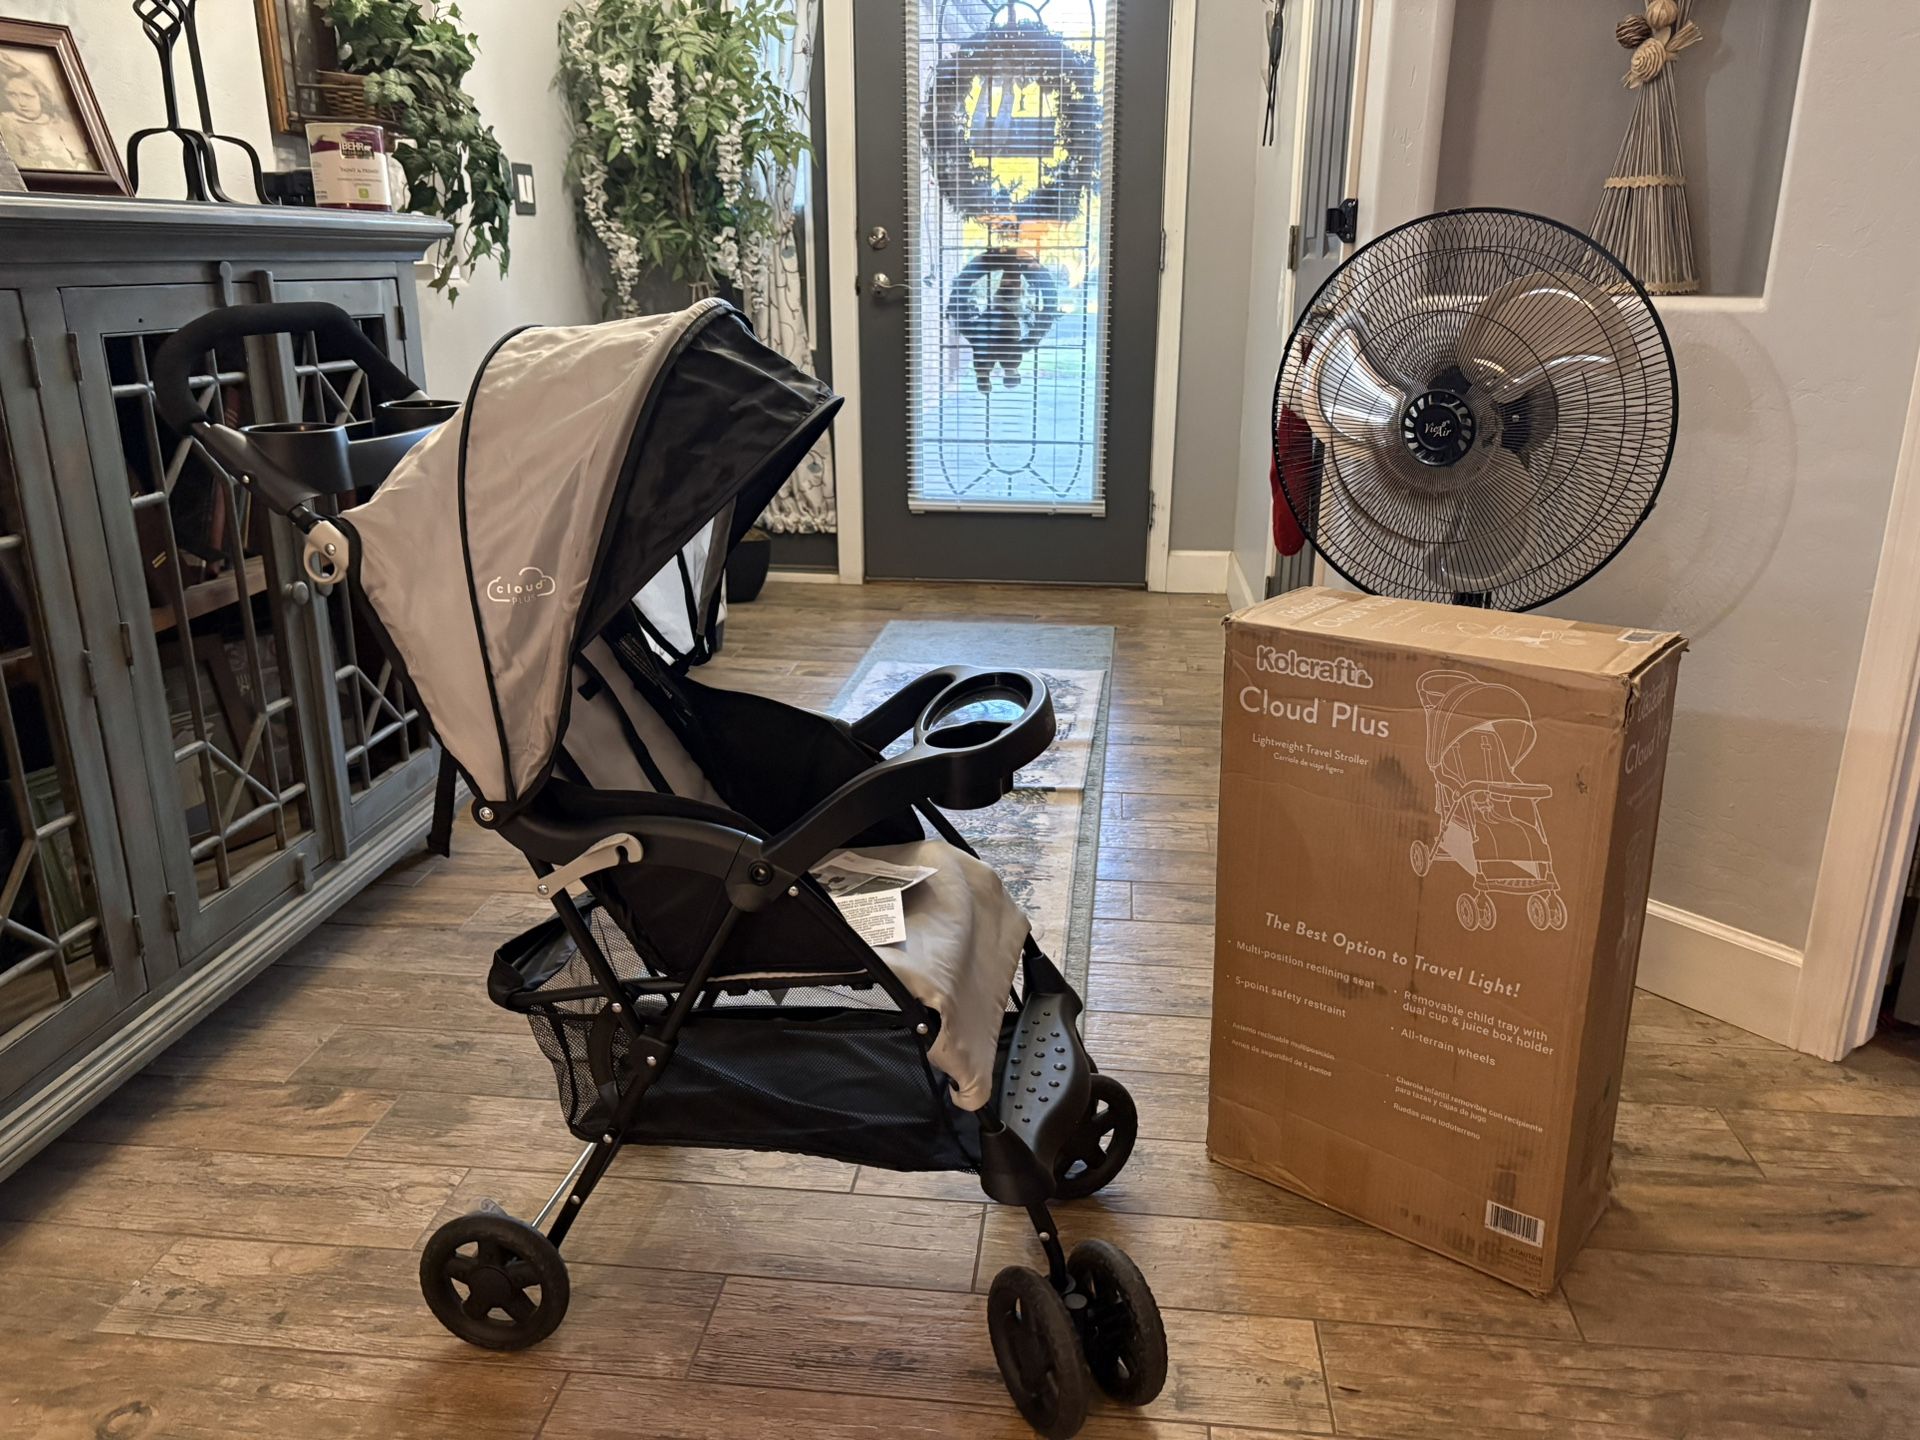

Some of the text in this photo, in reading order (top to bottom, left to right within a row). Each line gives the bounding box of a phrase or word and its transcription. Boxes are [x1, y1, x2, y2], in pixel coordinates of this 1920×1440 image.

[342, 141, 364, 150] BEHR
[496, 580, 542, 594] cloud
[1256, 645, 1357, 686] Kolcraft
[1239, 686, 1389, 738] Cloud Plus
[1252, 733, 1369, 766] Lightweight Travel Stroller
[1236, 940, 1375, 990] Multi-position reclining seat
[1266, 912, 1521, 998] The Best Option to Travel Light!
[1235, 976, 1346, 1018] 5-point safety restraint
[1404, 990, 1548, 1042] Removable child tray with
[1400, 1028, 1496, 1066] All-terrain wheels
[1402, 1002, 1554, 1056] dual cup & juice box holder
[1395, 1086, 1410, 1096] para
[1412, 1092, 1432, 1103] tazas
[1438, 1101, 1458, 1112] cajas
[1460, 1108, 1468, 1116] de
[1420, 1113, 1436, 1124] para
[1424, 1086, 1450, 1100] infantil
[1450, 1094, 1488, 1114] removible
